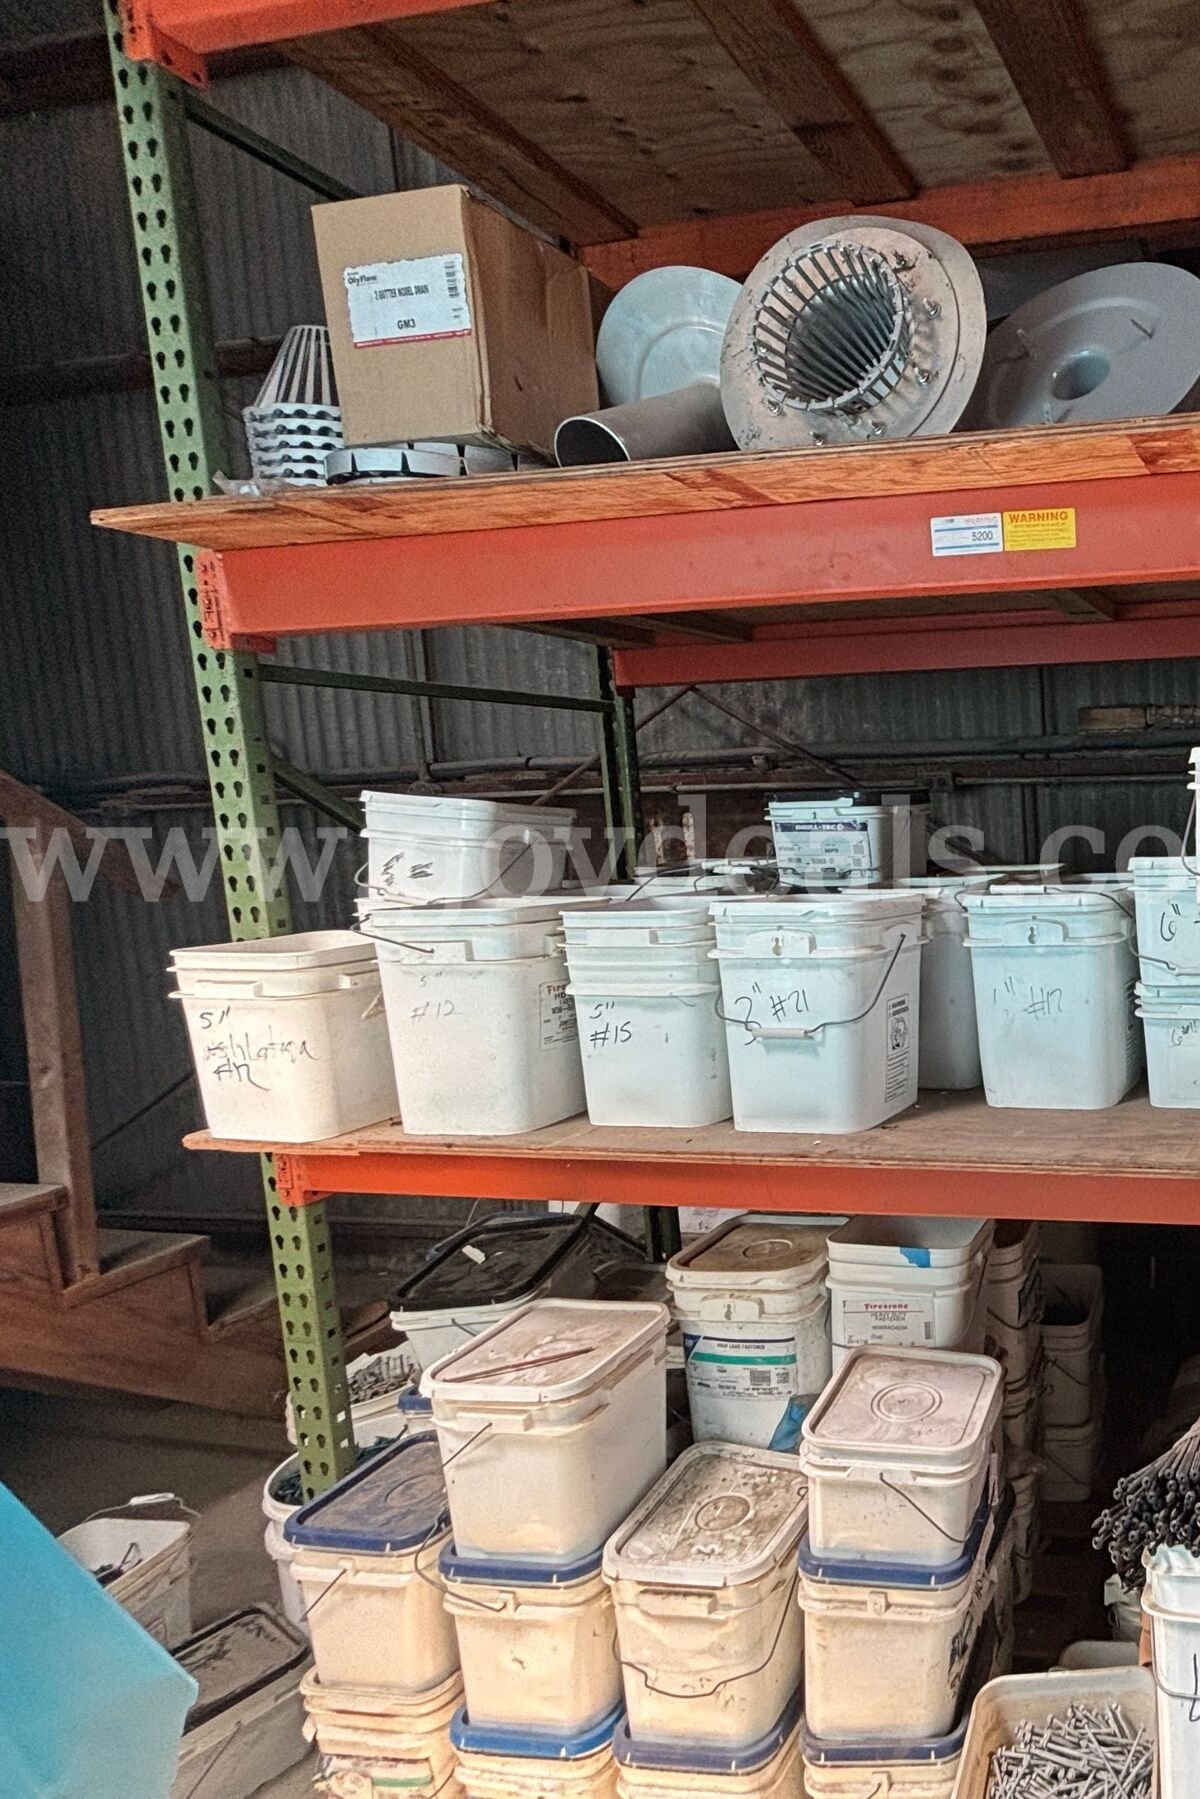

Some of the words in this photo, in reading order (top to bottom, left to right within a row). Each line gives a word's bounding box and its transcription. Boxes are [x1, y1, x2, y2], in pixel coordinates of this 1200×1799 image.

[397, 319, 416, 330] GM3
[1009, 511, 1068, 524] WARNING
[971, 531, 994, 542] 5200
[1160, 903, 1181, 942] 6"
[770, 988, 810, 1024] #21
[199, 1005, 231, 1030] 5"
[590, 1022, 633, 1049] #15
[863, 1303, 909, 1311] Firestone
